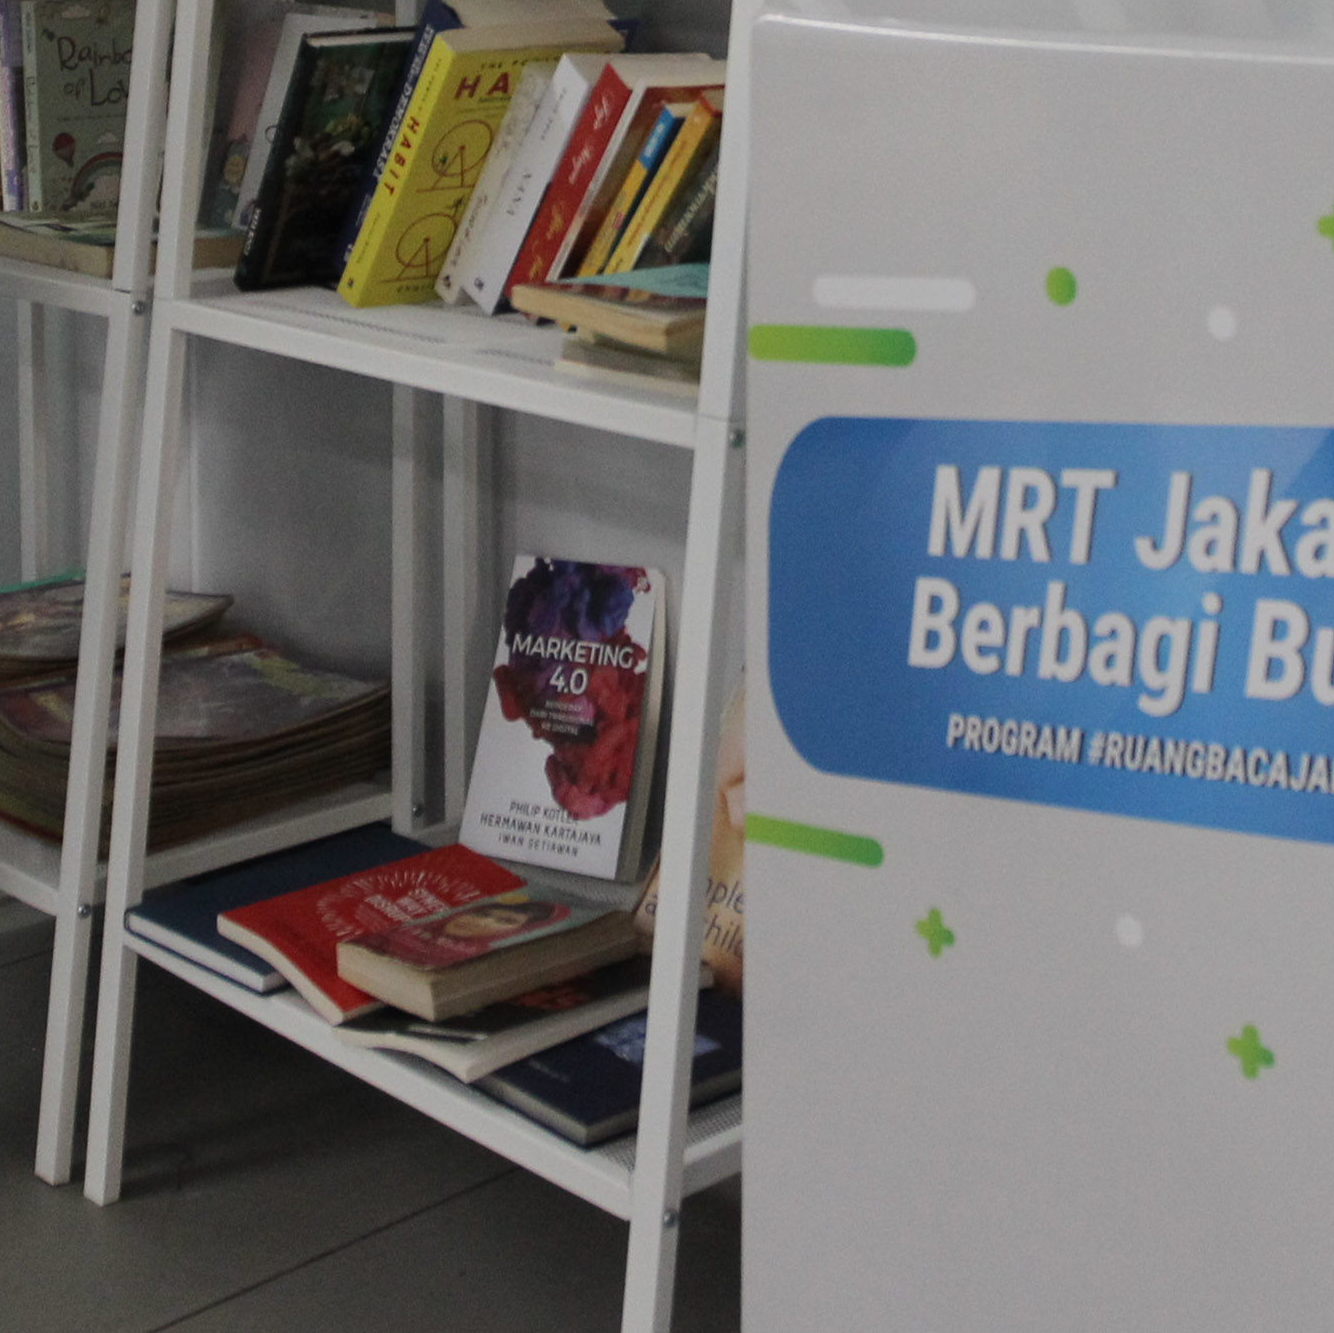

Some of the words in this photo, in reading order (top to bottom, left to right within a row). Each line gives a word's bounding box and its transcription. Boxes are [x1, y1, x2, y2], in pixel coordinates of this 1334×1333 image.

[58, 37, 132, 71] Rainbo
[382, 115, 420, 196] HABIT
[927, 464, 1118, 565] MRT
[512, 633, 635, 669] MARKETING
[907, 576, 1223, 716] Berbagi
[549, 666, 588, 694] 4.0
[947, 713, 1083, 763] PROGRAM
[480, 813, 541, 834] HERMAWAN
[545, 826, 601, 845] KARTAJAYA
[510, 801, 541, 816] PHILIP
[543, 809, 580, 825] KOTLER
[499, 833, 524, 846] IWAN
[529, 839, 578, 857] SETIAWAN
